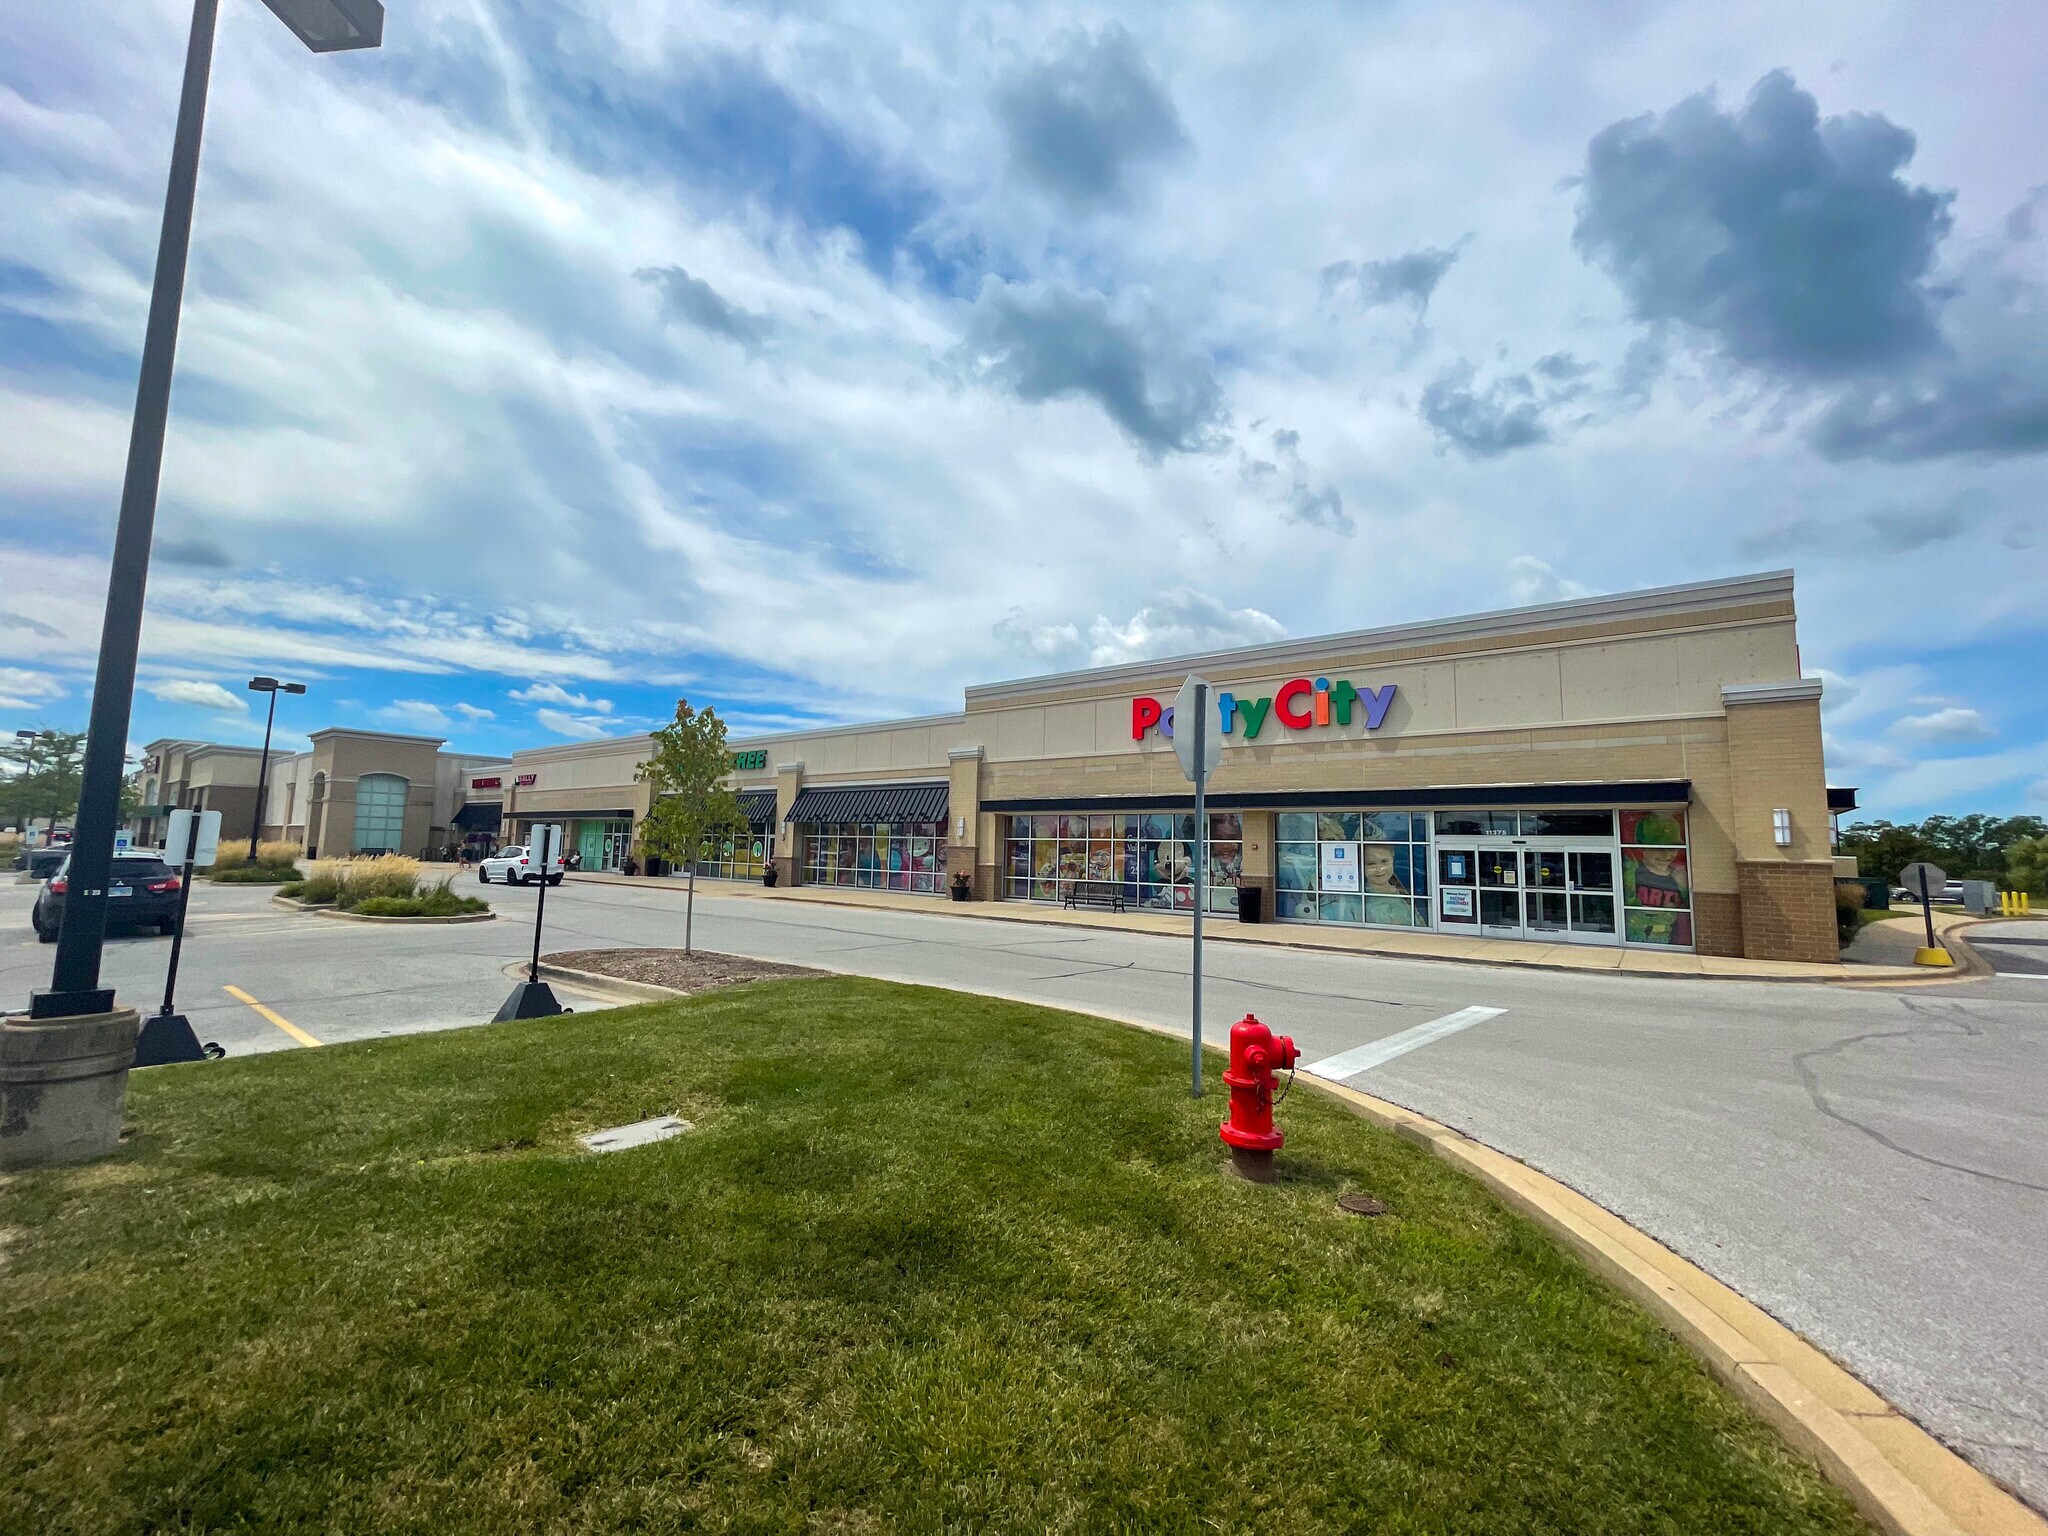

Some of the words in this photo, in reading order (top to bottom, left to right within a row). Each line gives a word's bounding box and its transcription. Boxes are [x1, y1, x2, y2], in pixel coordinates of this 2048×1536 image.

[1132, 692, 1272, 740] Pty
[1274, 677, 1398, 730] City
[732, 750, 768, 770] REE
